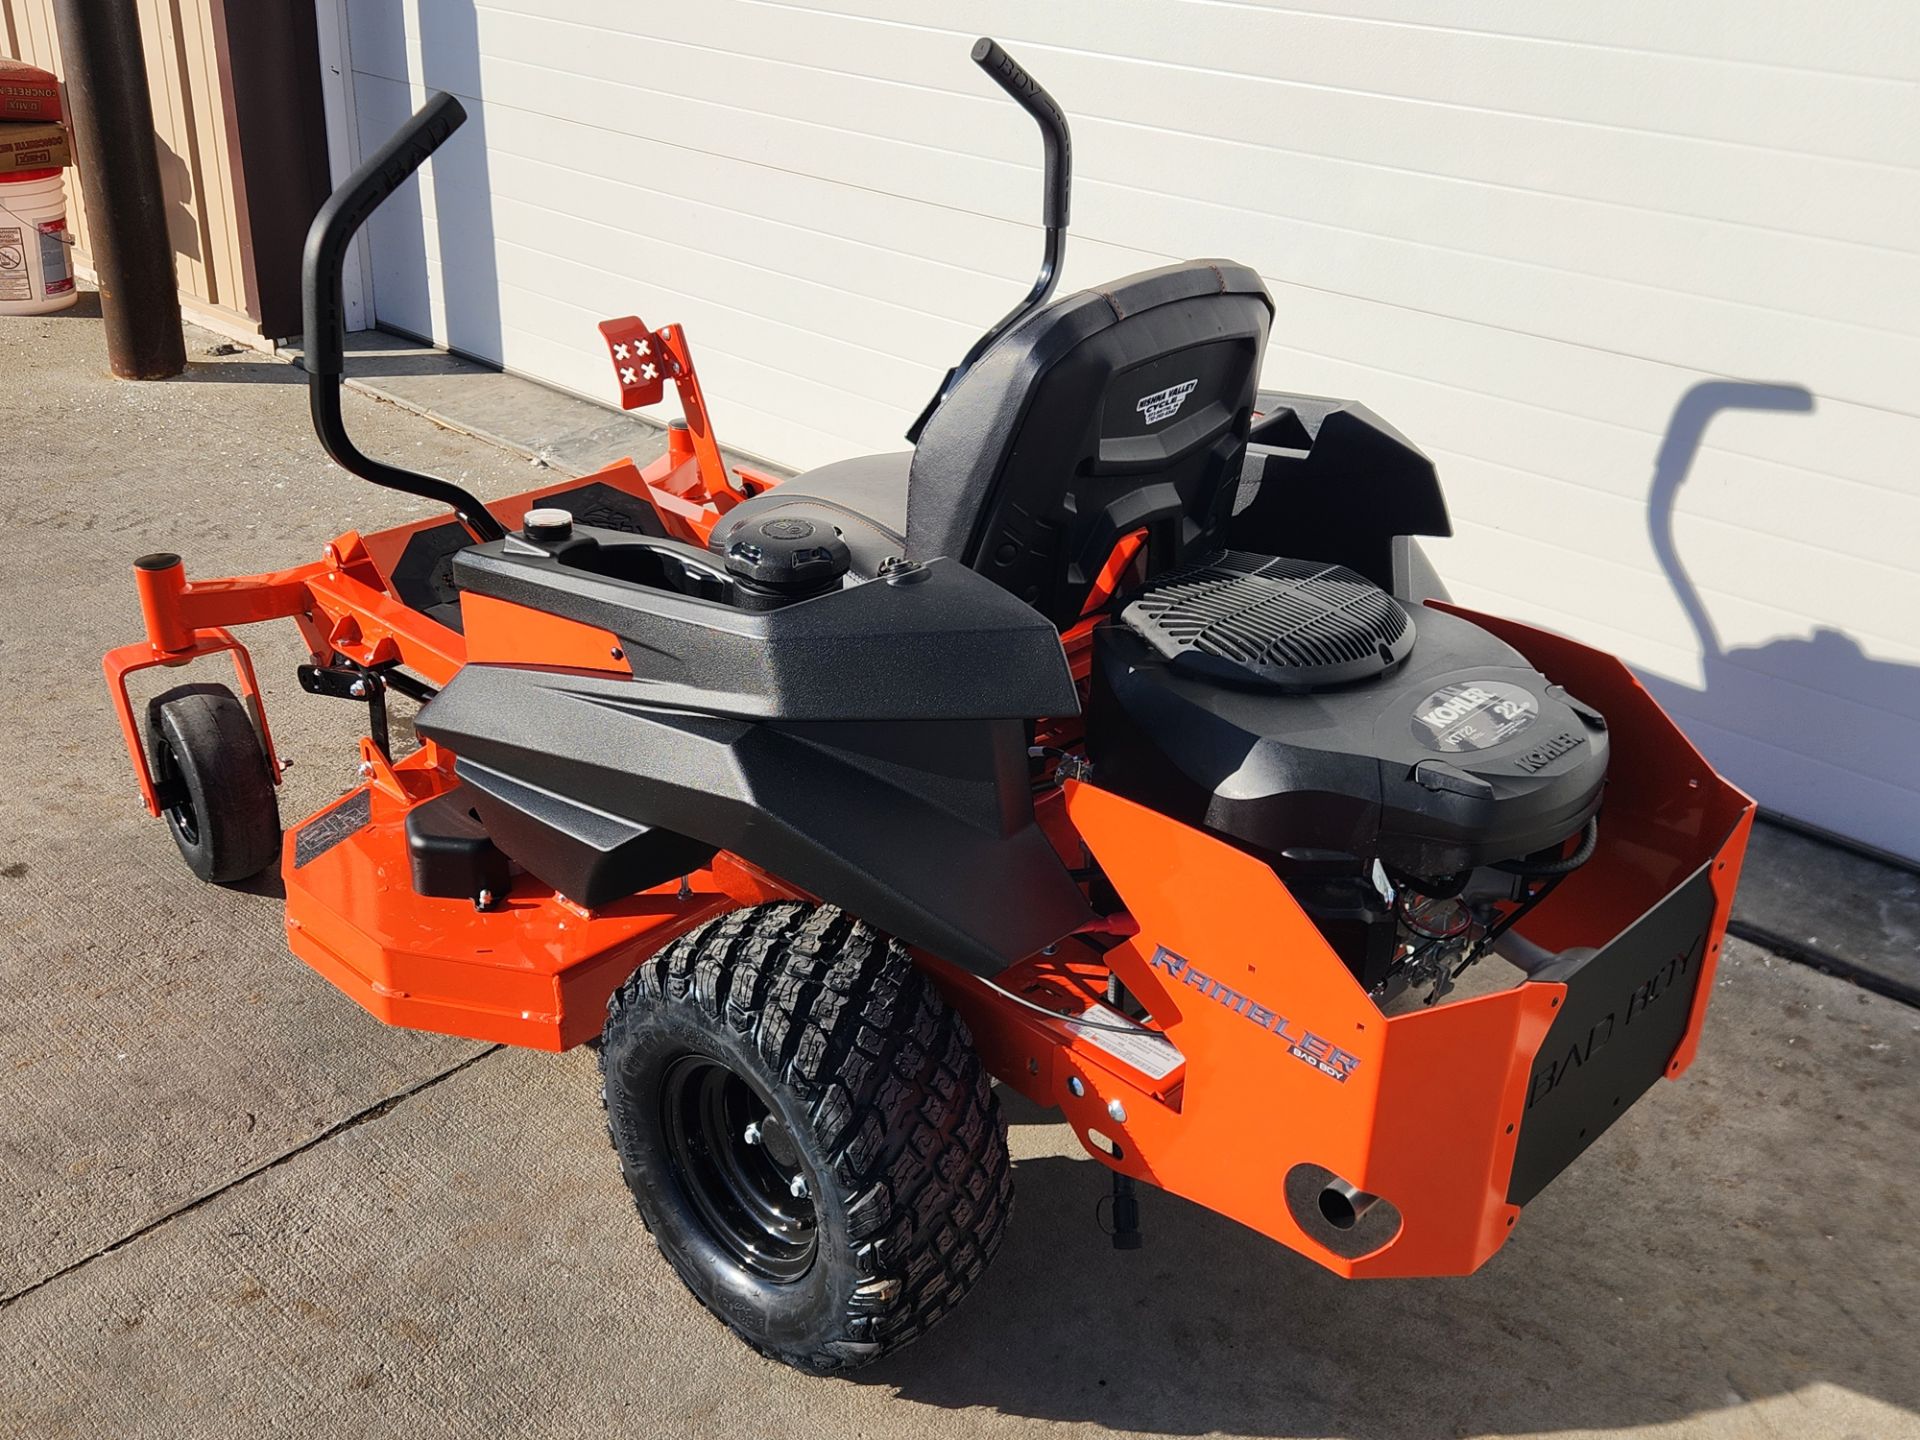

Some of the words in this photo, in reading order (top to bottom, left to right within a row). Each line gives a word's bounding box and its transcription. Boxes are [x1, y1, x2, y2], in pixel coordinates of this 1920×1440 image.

[7, 86, 57, 97] CONCRETE
[998, 54, 1042, 98] BOY
[1167, 382, 1195, 398] VALLEY
[1422, 688, 1496, 728] KOHLER
[1514, 733, 1585, 774] KOHLER
[1150, 943, 1361, 1075] RAMBLER
[1528, 1013, 1615, 1109] BAD
[1625, 934, 1701, 1025] BOY
[1293, 1047, 1318, 1067] BAD
[1319, 1061, 1344, 1080] BOY
